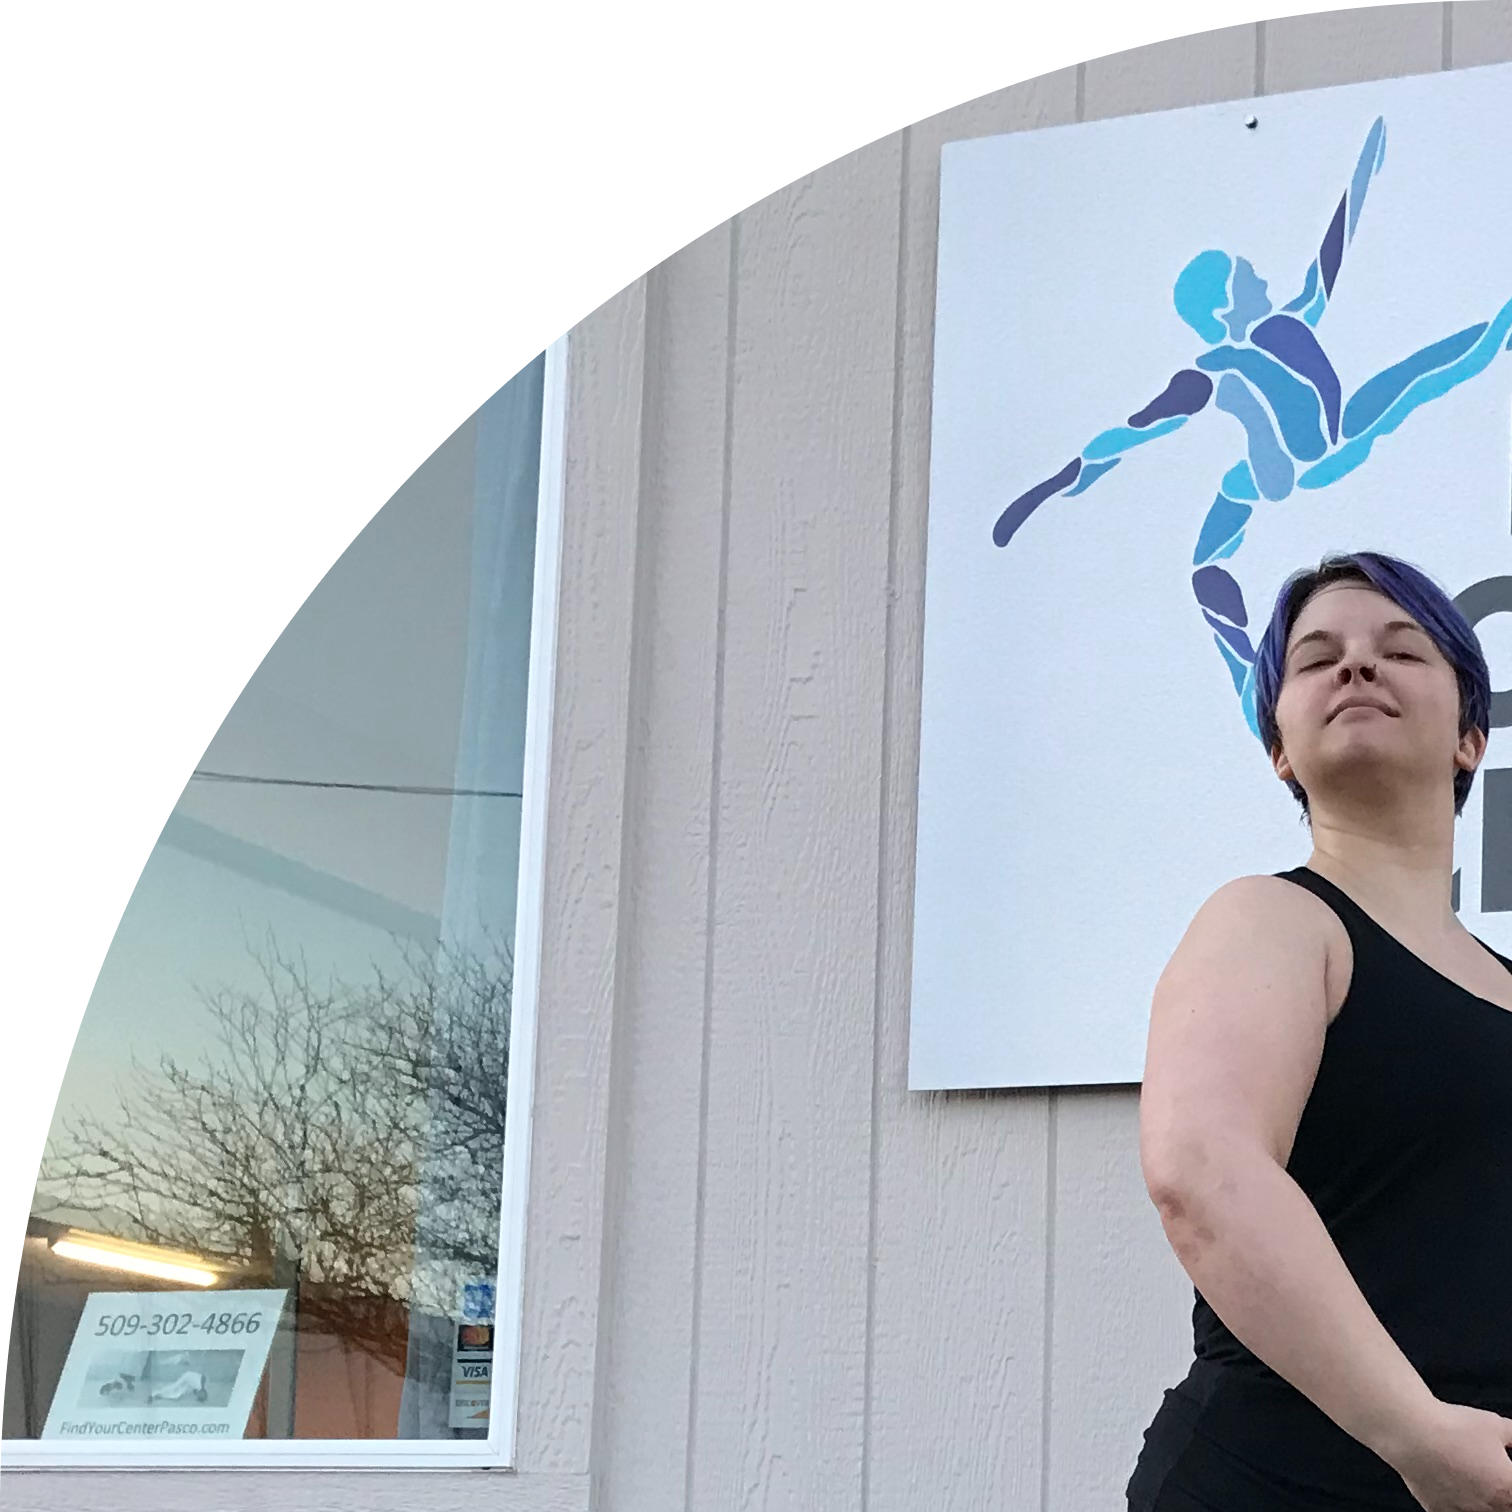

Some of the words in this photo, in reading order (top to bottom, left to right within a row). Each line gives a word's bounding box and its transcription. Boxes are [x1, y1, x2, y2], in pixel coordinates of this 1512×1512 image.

[94, 1312, 263, 1337] 509-302-4866
[462, 1365, 489, 1378] VISA
[60, 1420, 230, 1435] FindYourCenterPasco.com
